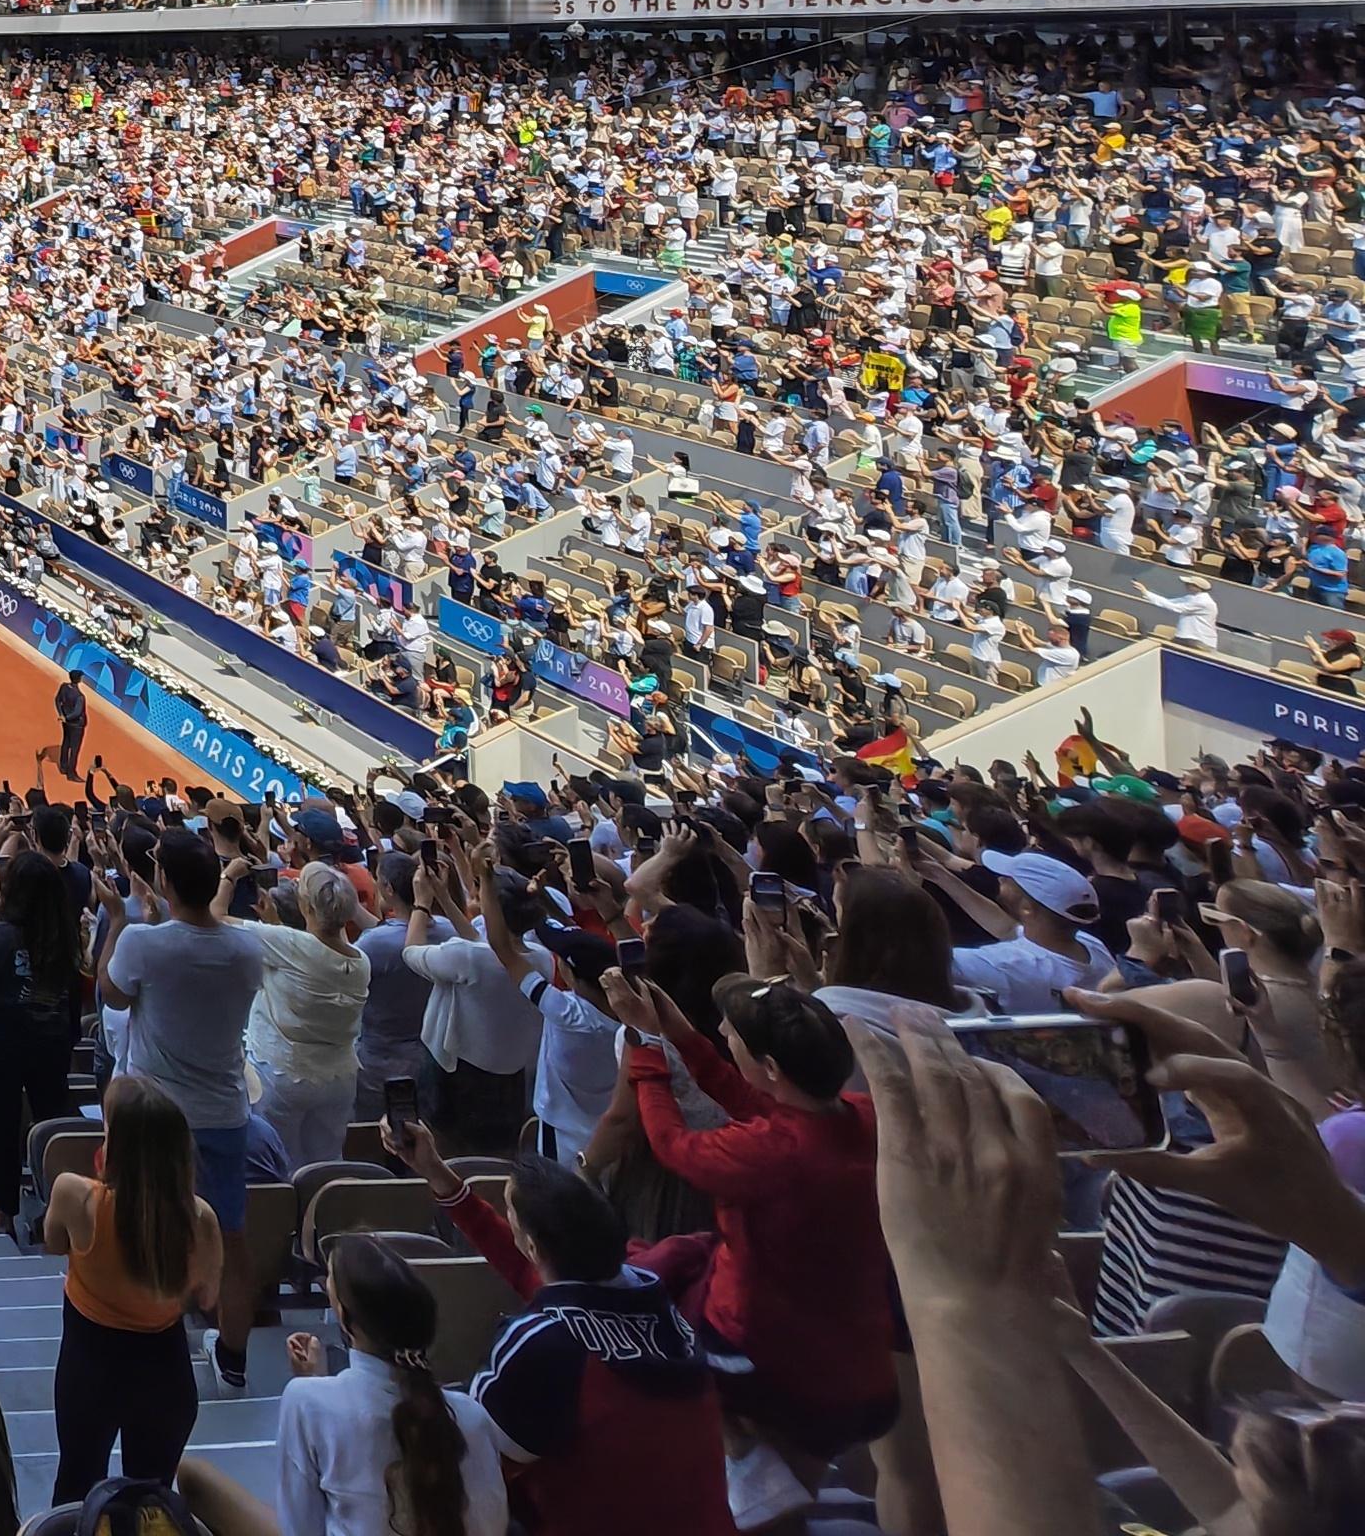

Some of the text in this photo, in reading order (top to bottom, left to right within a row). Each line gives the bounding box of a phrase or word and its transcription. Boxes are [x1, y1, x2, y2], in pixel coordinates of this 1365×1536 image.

[588, 0, 617, 14] TO
[588, 675, 624, 703] 202
[1274, 703, 1360, 742] PARIS
[179, 718, 246, 779] PARIS
